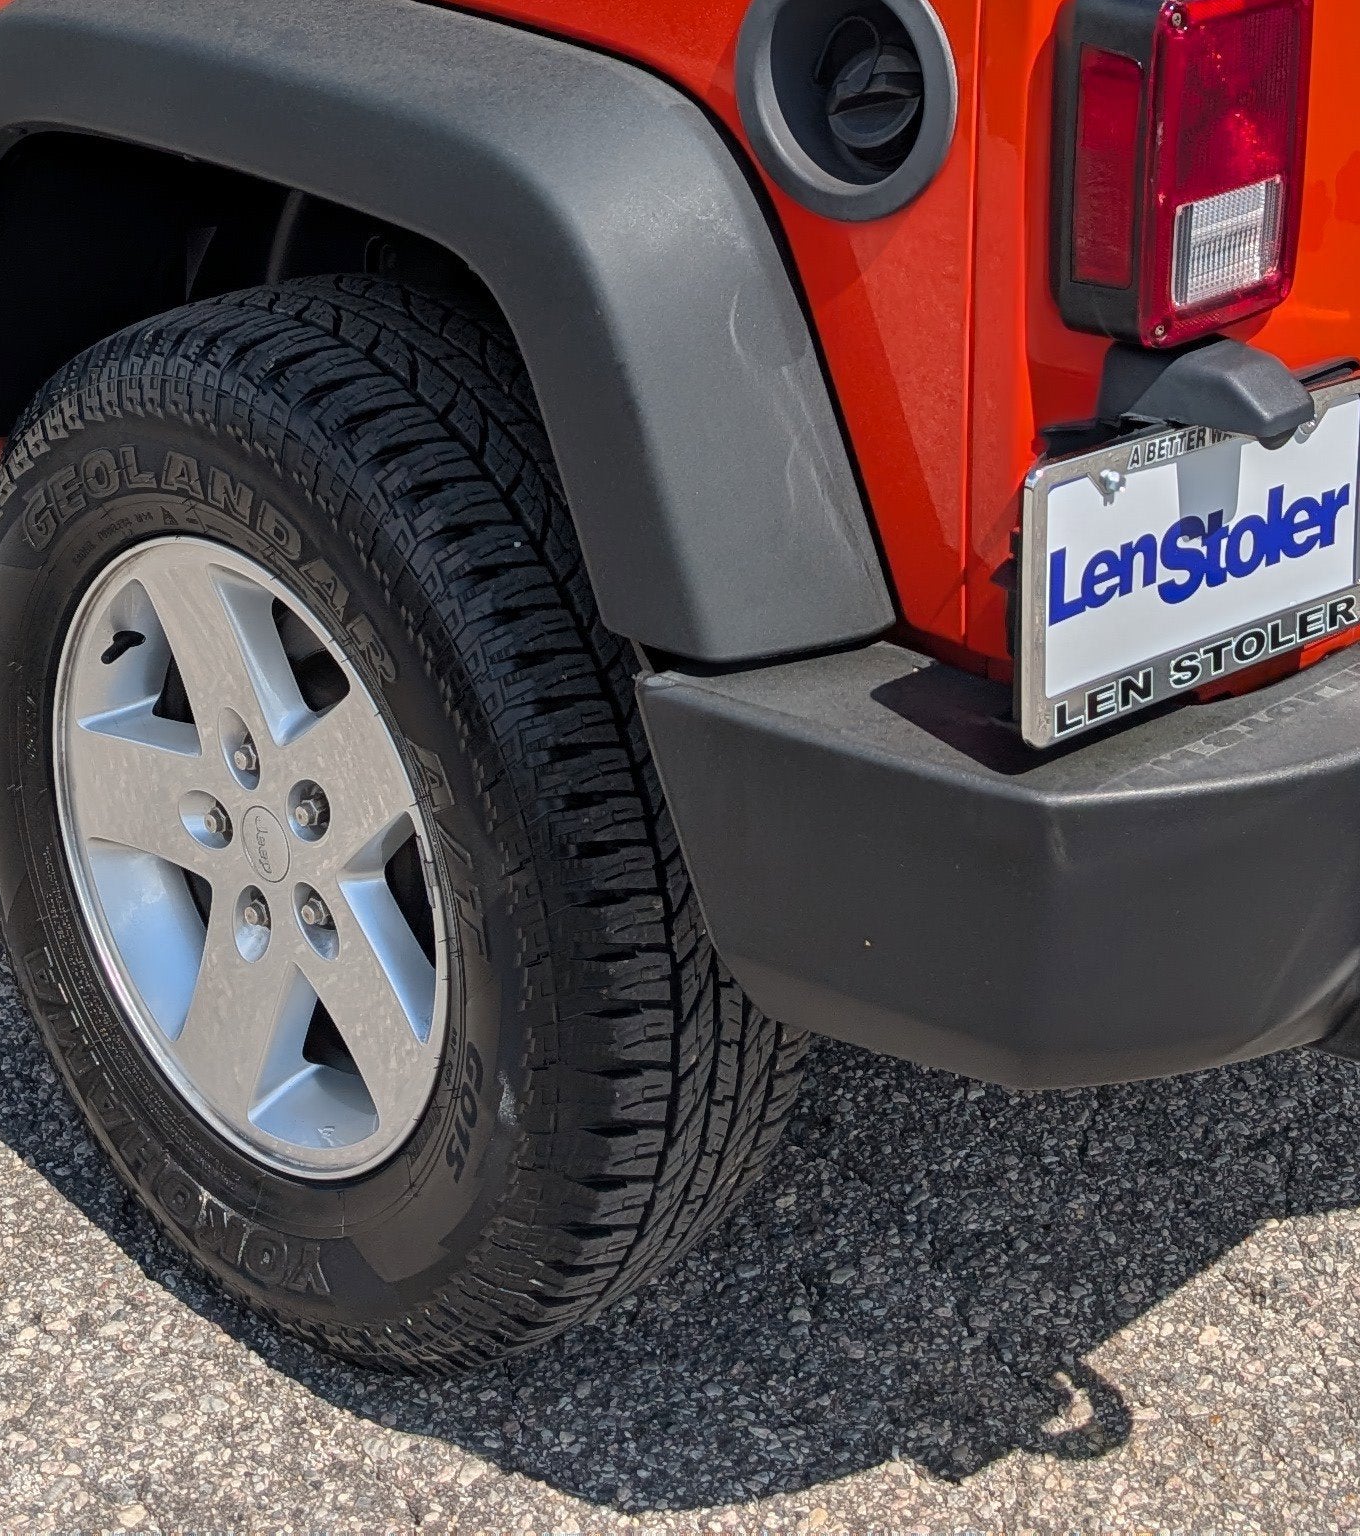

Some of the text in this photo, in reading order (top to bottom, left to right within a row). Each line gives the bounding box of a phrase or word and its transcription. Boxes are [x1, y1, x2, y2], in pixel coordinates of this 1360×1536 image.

[1127, 444, 1141, 470] A
[1144, 426, 1207, 465] BETTER
[23, 443, 397, 685] GEOLANDAR
[1054, 594, 1359, 738] LEN STOLER
[254, 815, 273, 874] Jeep
[22, 949, 332, 1298] YOKOHAMA
